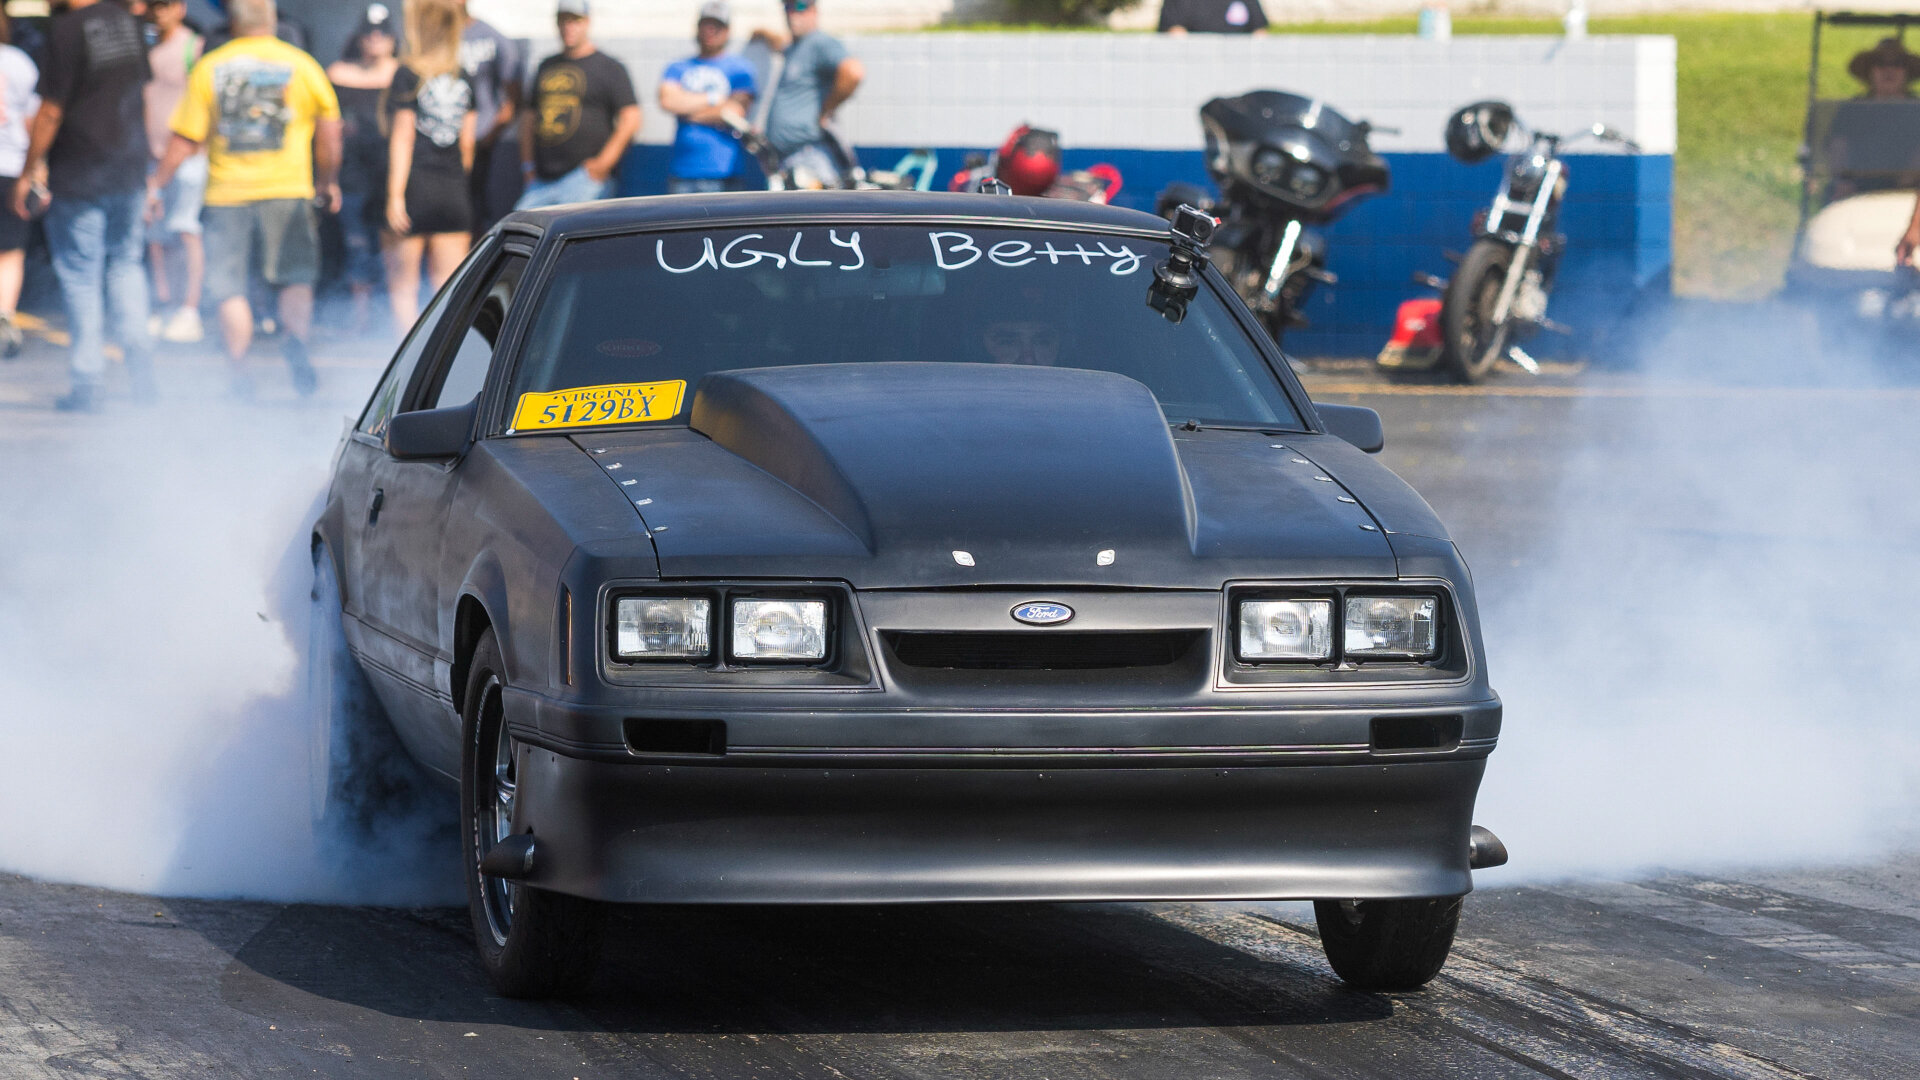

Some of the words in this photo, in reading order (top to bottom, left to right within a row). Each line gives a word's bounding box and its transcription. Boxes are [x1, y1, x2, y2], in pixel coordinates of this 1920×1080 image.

[655, 229, 865, 274] UGLY
[561, 388, 643, 403] VIRGINIA
[538, 394, 657, 425] 5129BX
[1026, 606, 1058, 618] Ford
